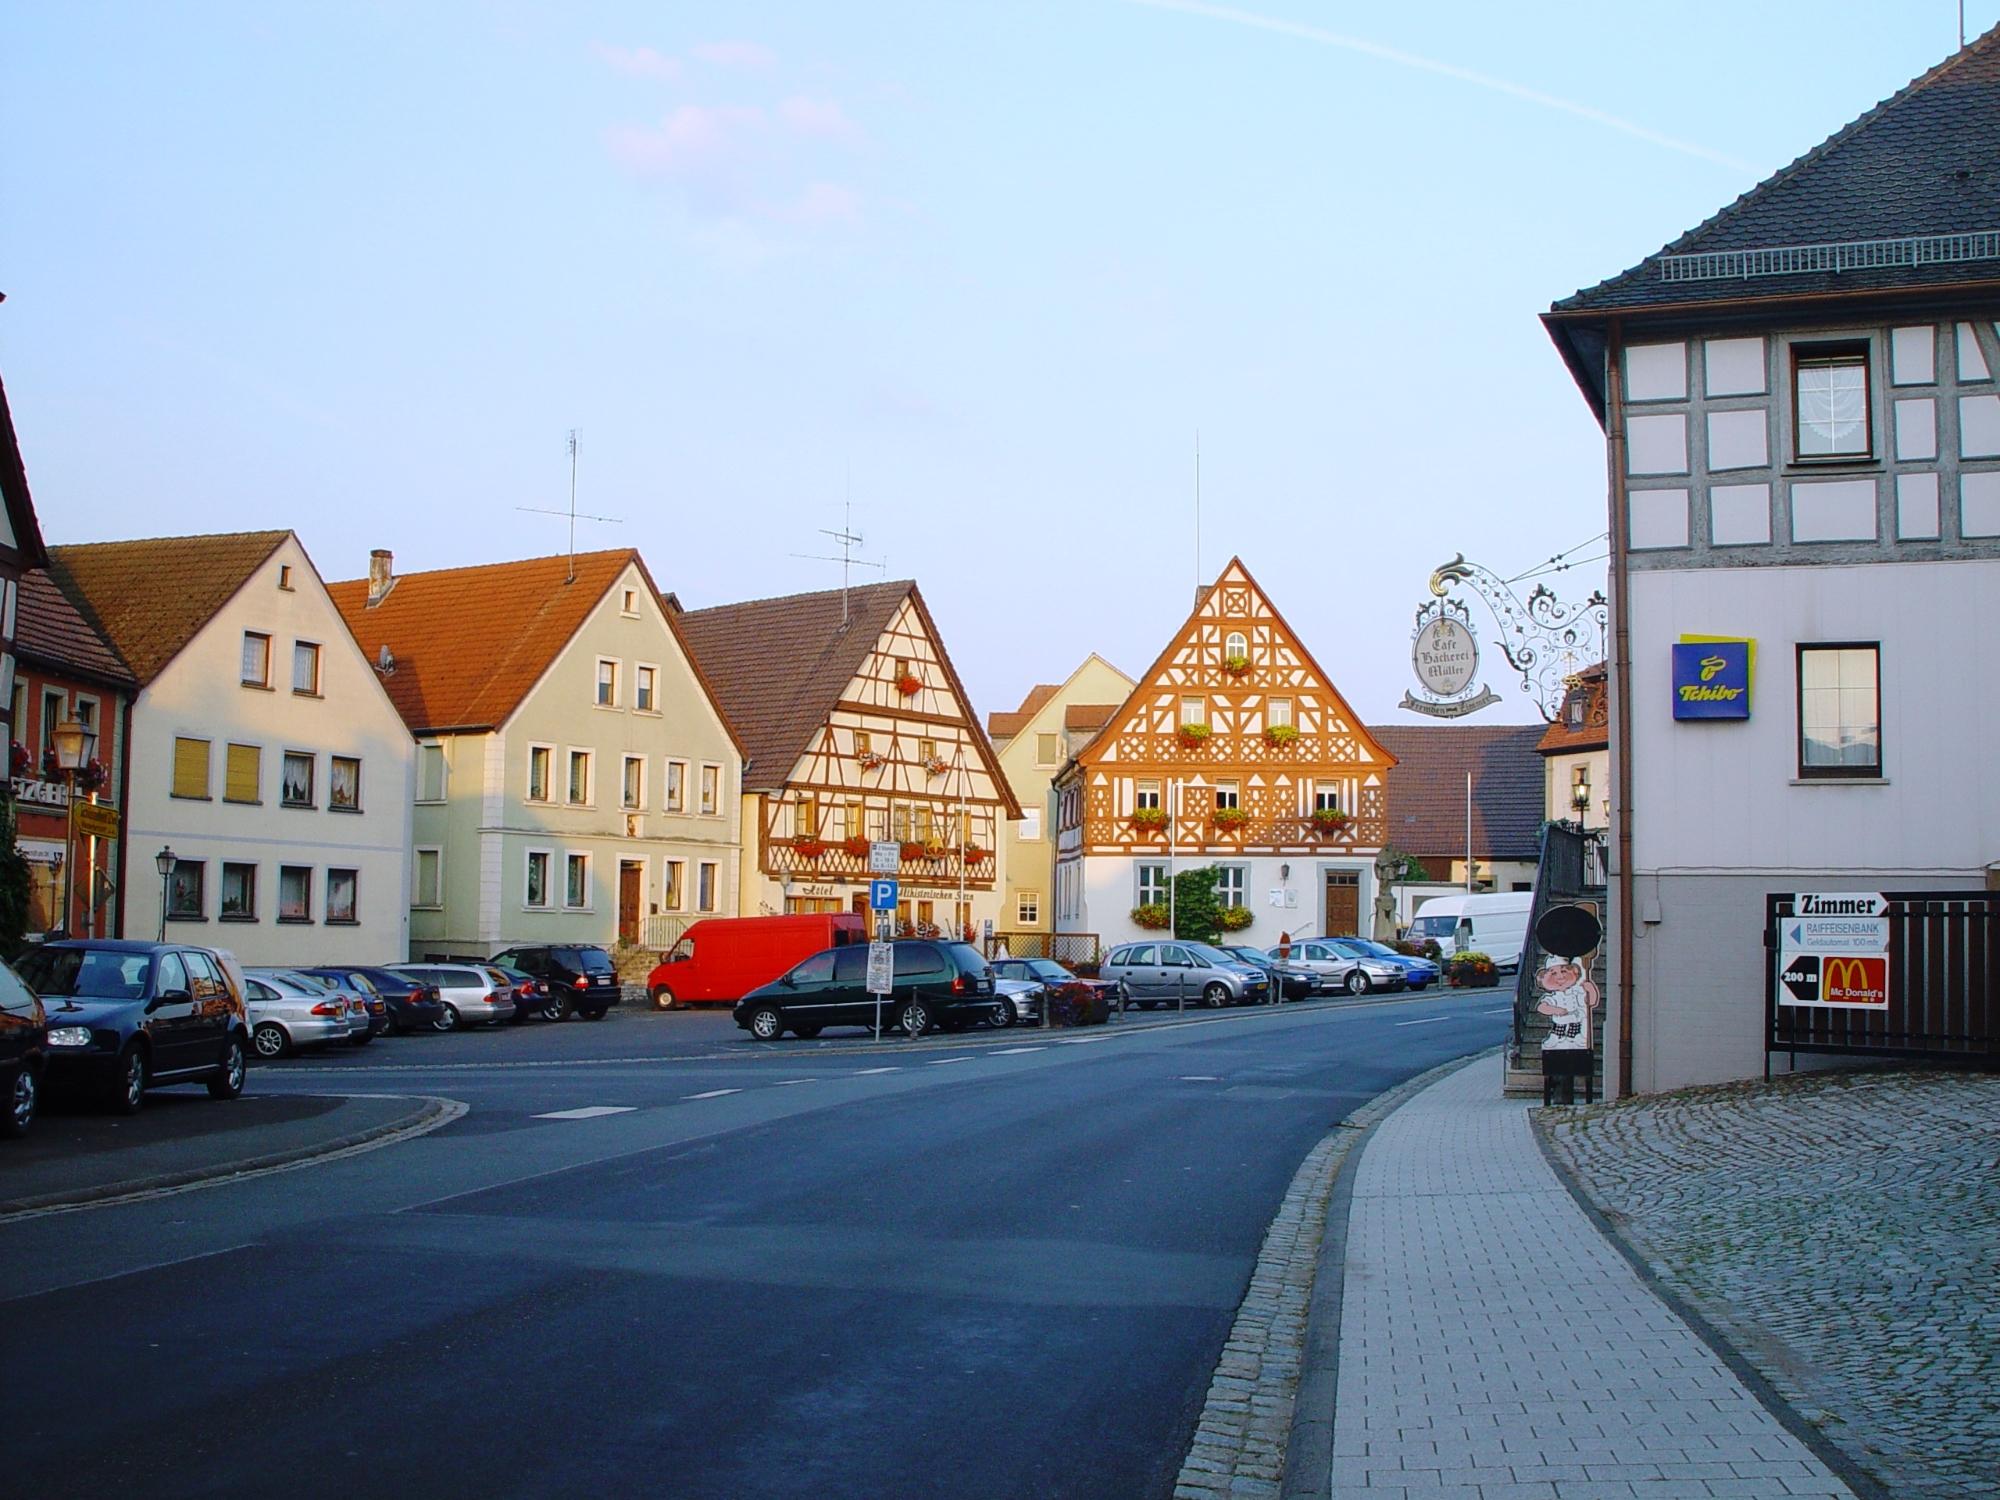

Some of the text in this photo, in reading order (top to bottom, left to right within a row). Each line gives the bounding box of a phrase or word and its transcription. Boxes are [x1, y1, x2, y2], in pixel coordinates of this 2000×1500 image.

[1679, 684, 1744, 701] Tchibo
[877, 884, 892, 906] P
[1801, 895, 1876, 914] Zimmer
[1807, 923, 1879, 933] RAIFFEISENBANK
[1784, 972, 1818, 983] 200 m
